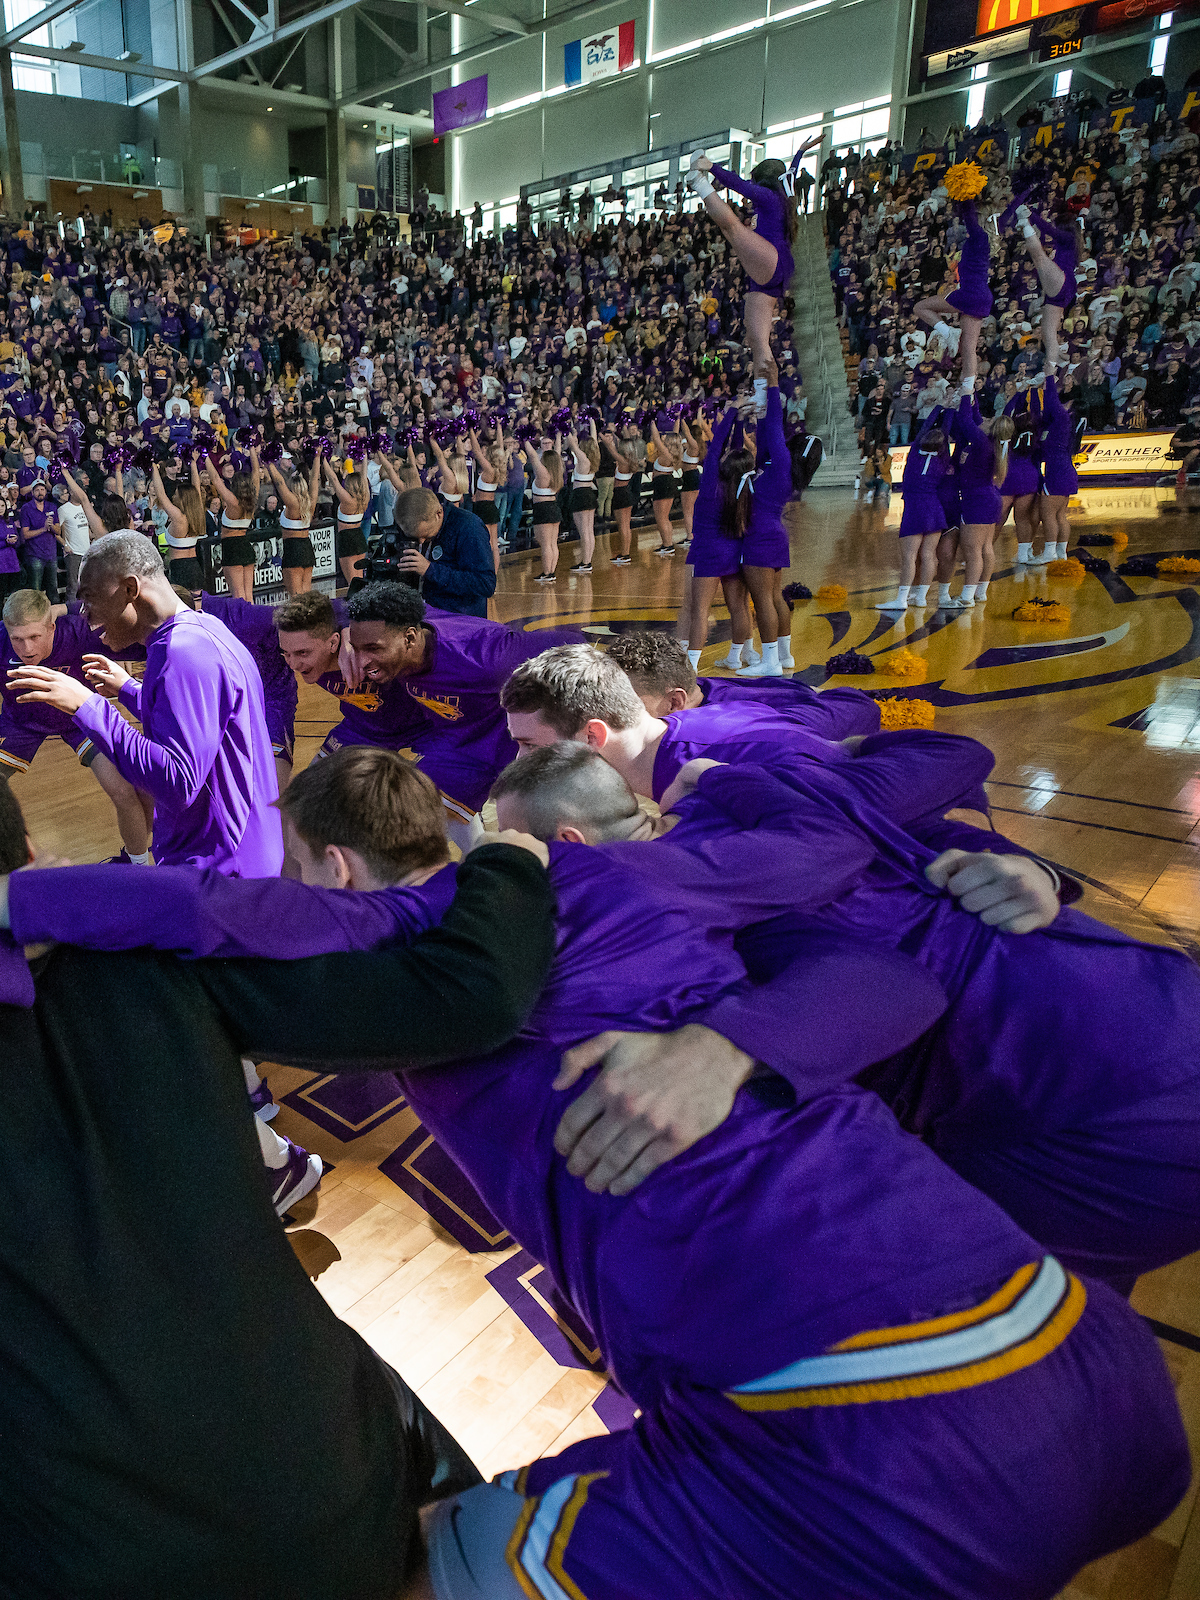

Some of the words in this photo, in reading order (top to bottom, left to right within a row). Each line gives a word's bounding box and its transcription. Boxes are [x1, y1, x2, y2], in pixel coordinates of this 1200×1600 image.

[1050, 38, 1082, 58] 3:04
[1095, 447, 1162, 457] PANTHER
[312, 529, 331, 542] YOUR
